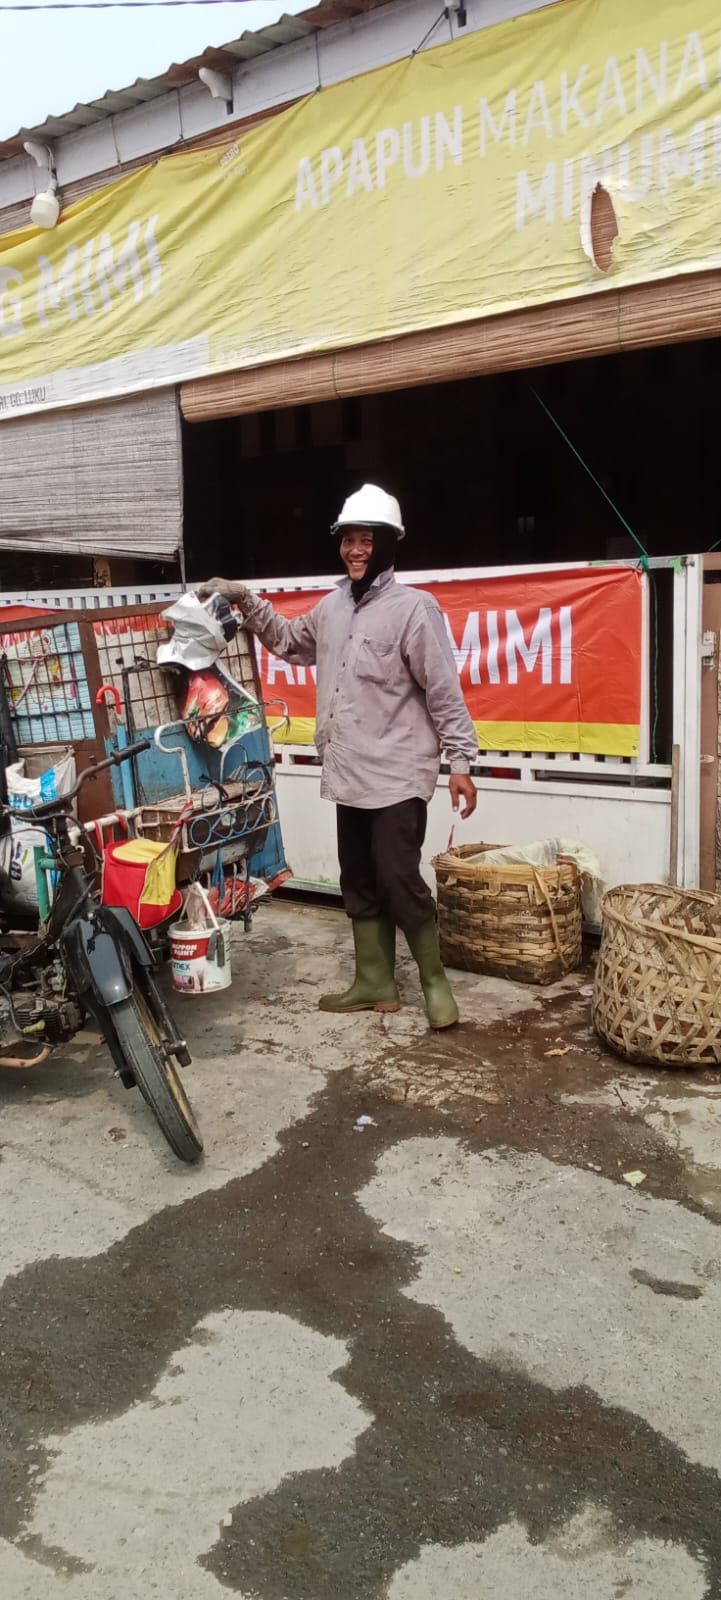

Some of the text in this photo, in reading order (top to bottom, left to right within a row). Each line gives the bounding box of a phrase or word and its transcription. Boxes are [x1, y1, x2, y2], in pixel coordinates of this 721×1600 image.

[294, 29, 721, 213] APAPUN MAKANA
[36, 215, 162, 328] MIMI
[444, 606, 573, 685] MIMI
